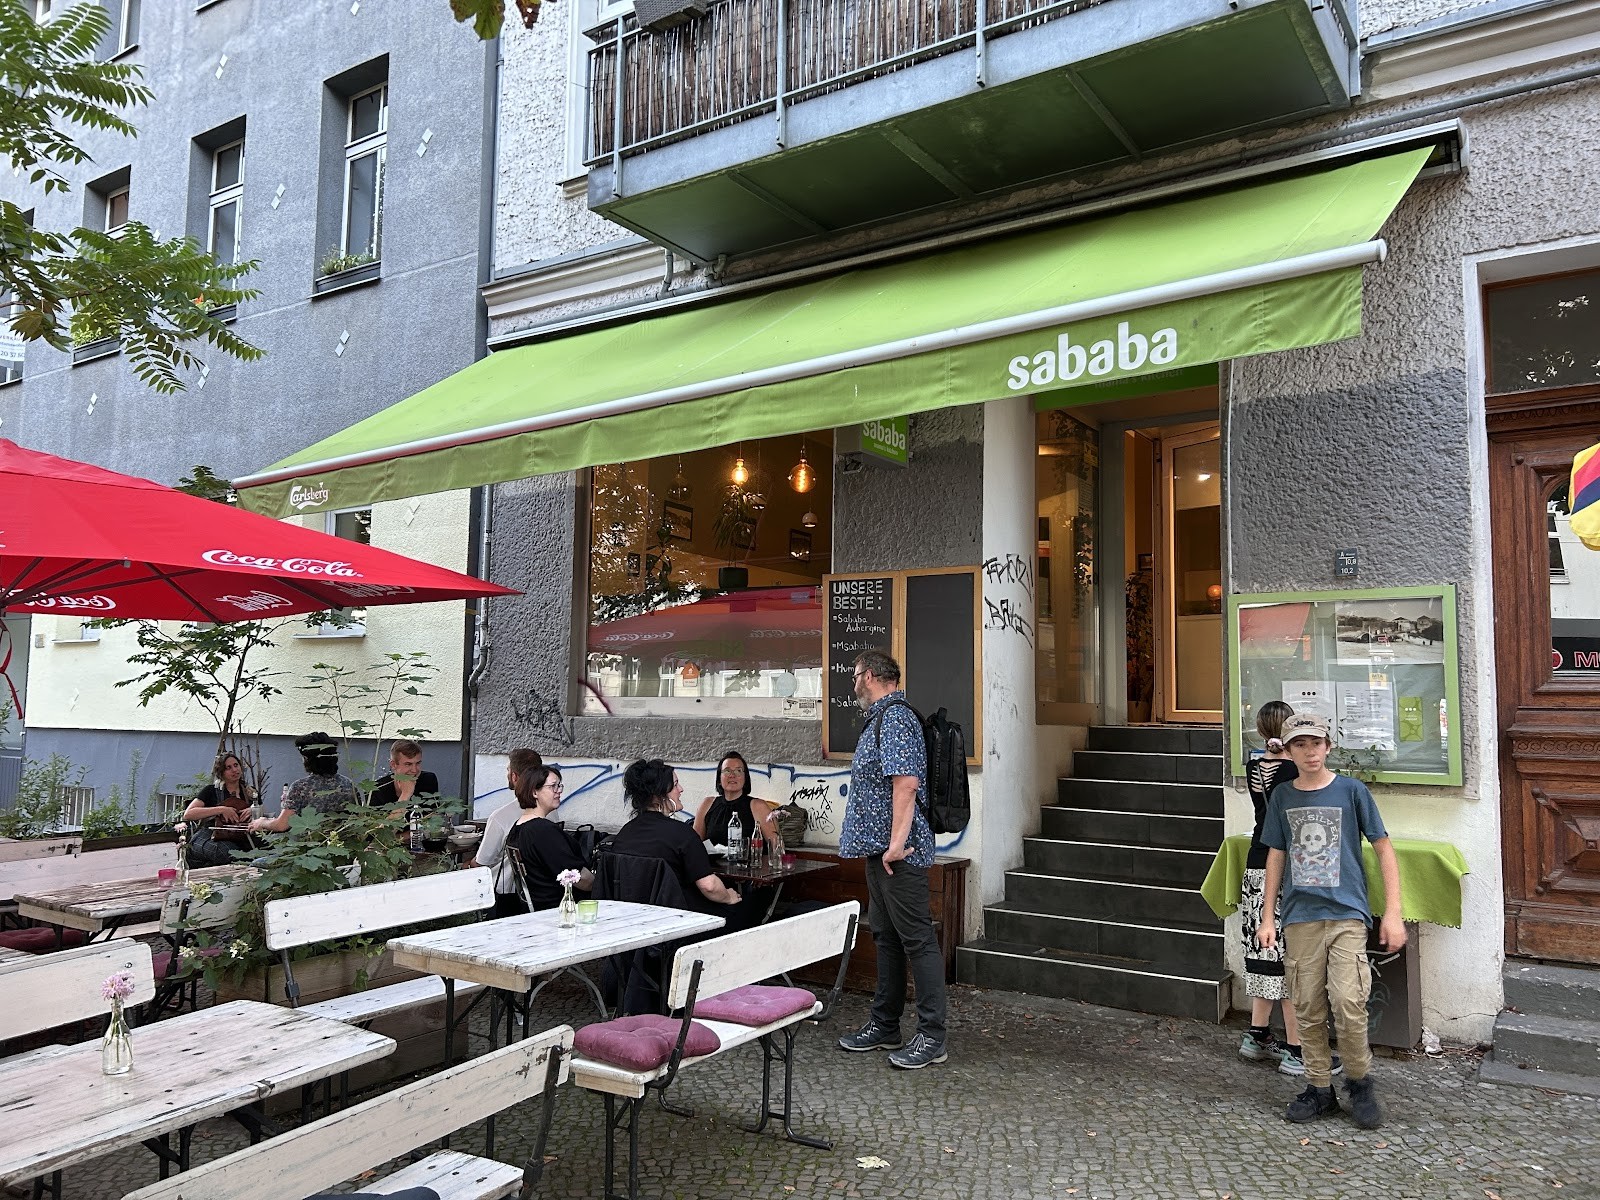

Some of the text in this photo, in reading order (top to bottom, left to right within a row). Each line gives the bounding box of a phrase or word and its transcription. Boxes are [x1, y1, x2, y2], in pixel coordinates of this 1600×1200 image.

[1007, 321, 1178, 390] sababa
[863, 420, 906, 450] sababa
[290, 483, 330, 509] Carlsberg
[202, 549, 356, 577] Coca-Cola
[1341, 567, 1354, 575] 10,2
[833, 580, 883, 594] UNSERE
[837, 613, 868, 623] Sababa
[846, 622, 886, 635] Aubergine
